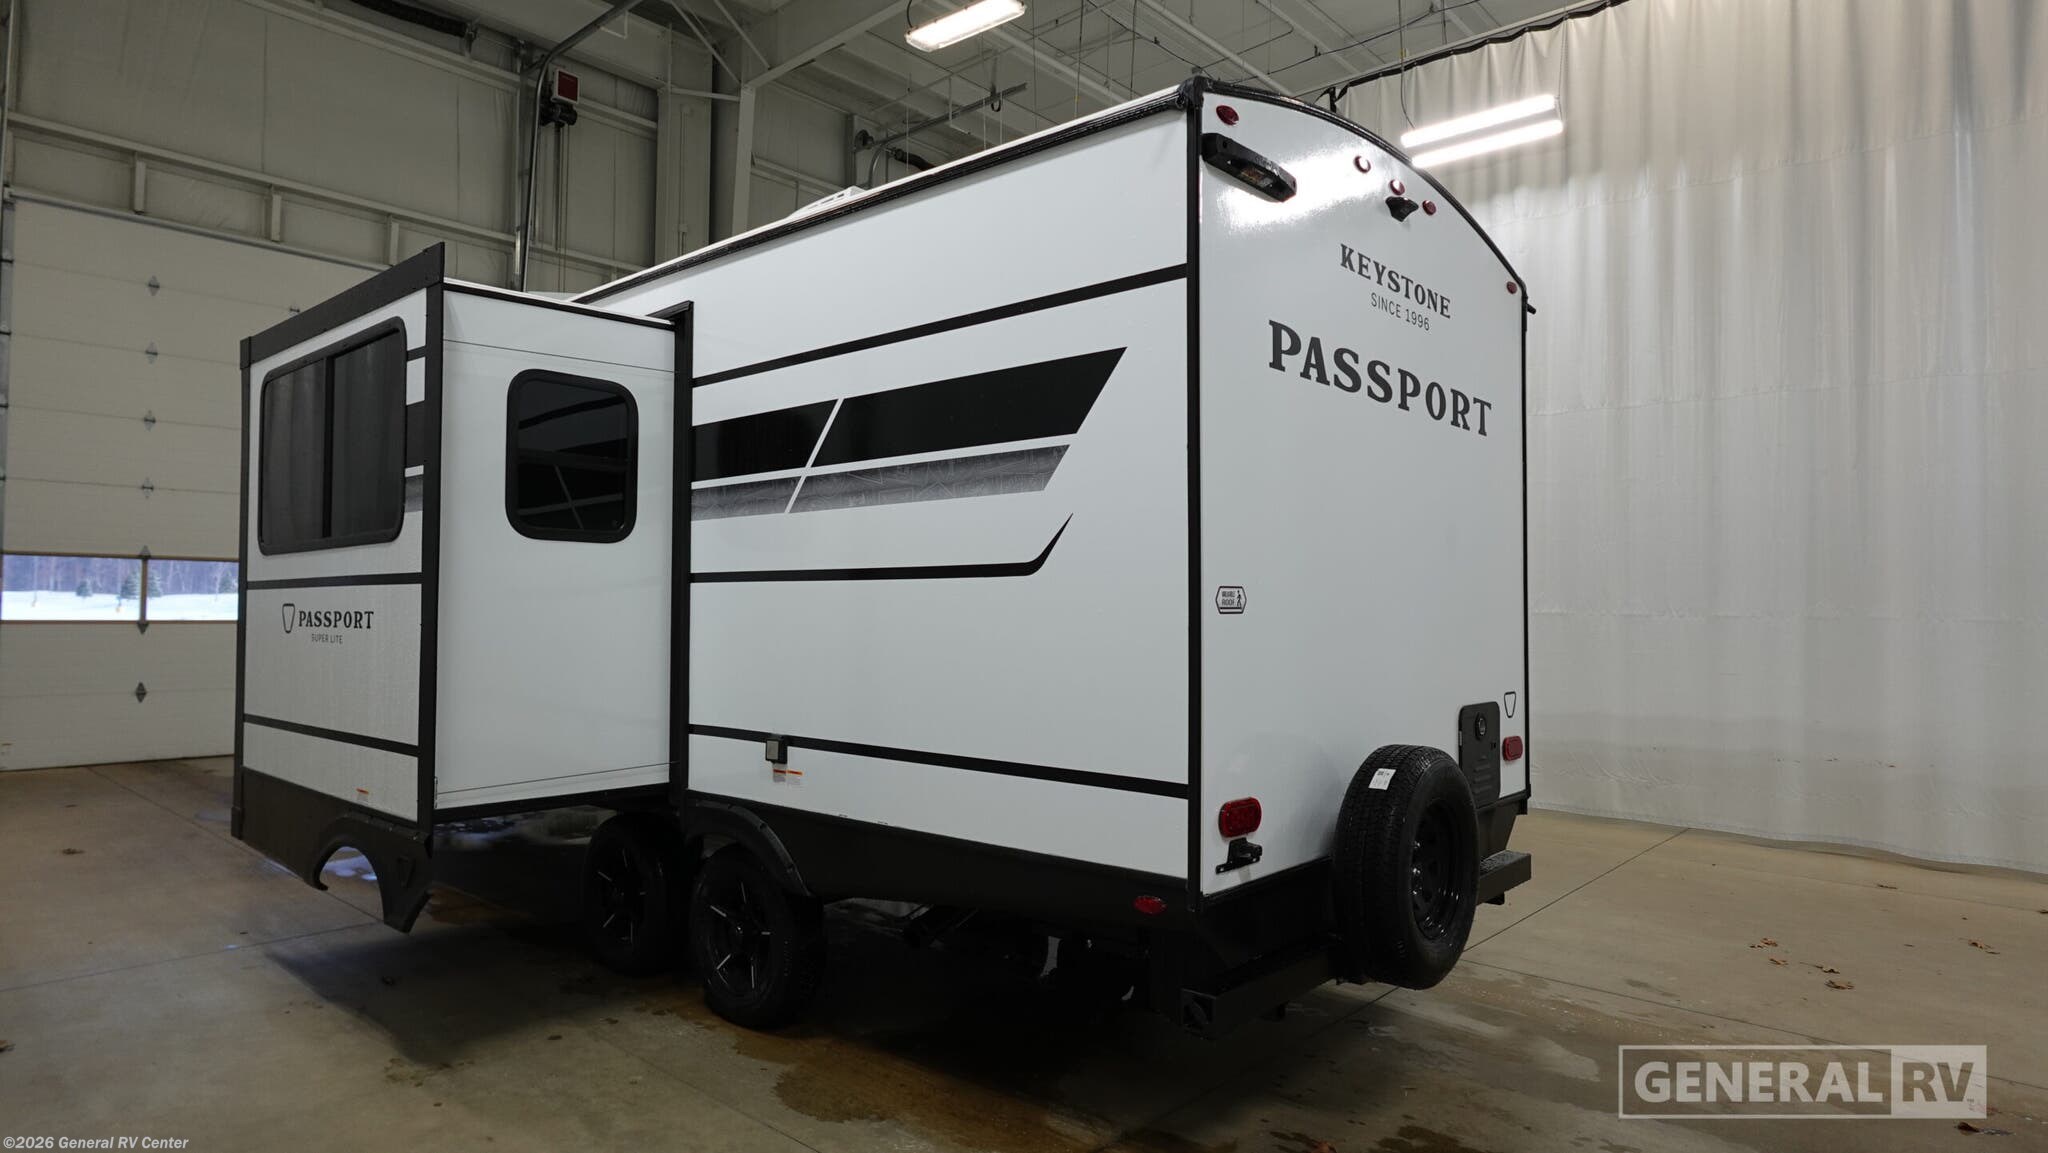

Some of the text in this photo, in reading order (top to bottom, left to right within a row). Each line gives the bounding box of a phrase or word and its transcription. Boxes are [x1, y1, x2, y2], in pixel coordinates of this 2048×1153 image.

[1340, 243, 1451, 319] KEYSTONE
[1371, 292, 1430, 331] SINCE 1996
[1269, 320, 1492, 436] PASSPORT
[299, 611, 374, 629] PASSPORT
[311, 634, 343, 645] SUPER LITE
